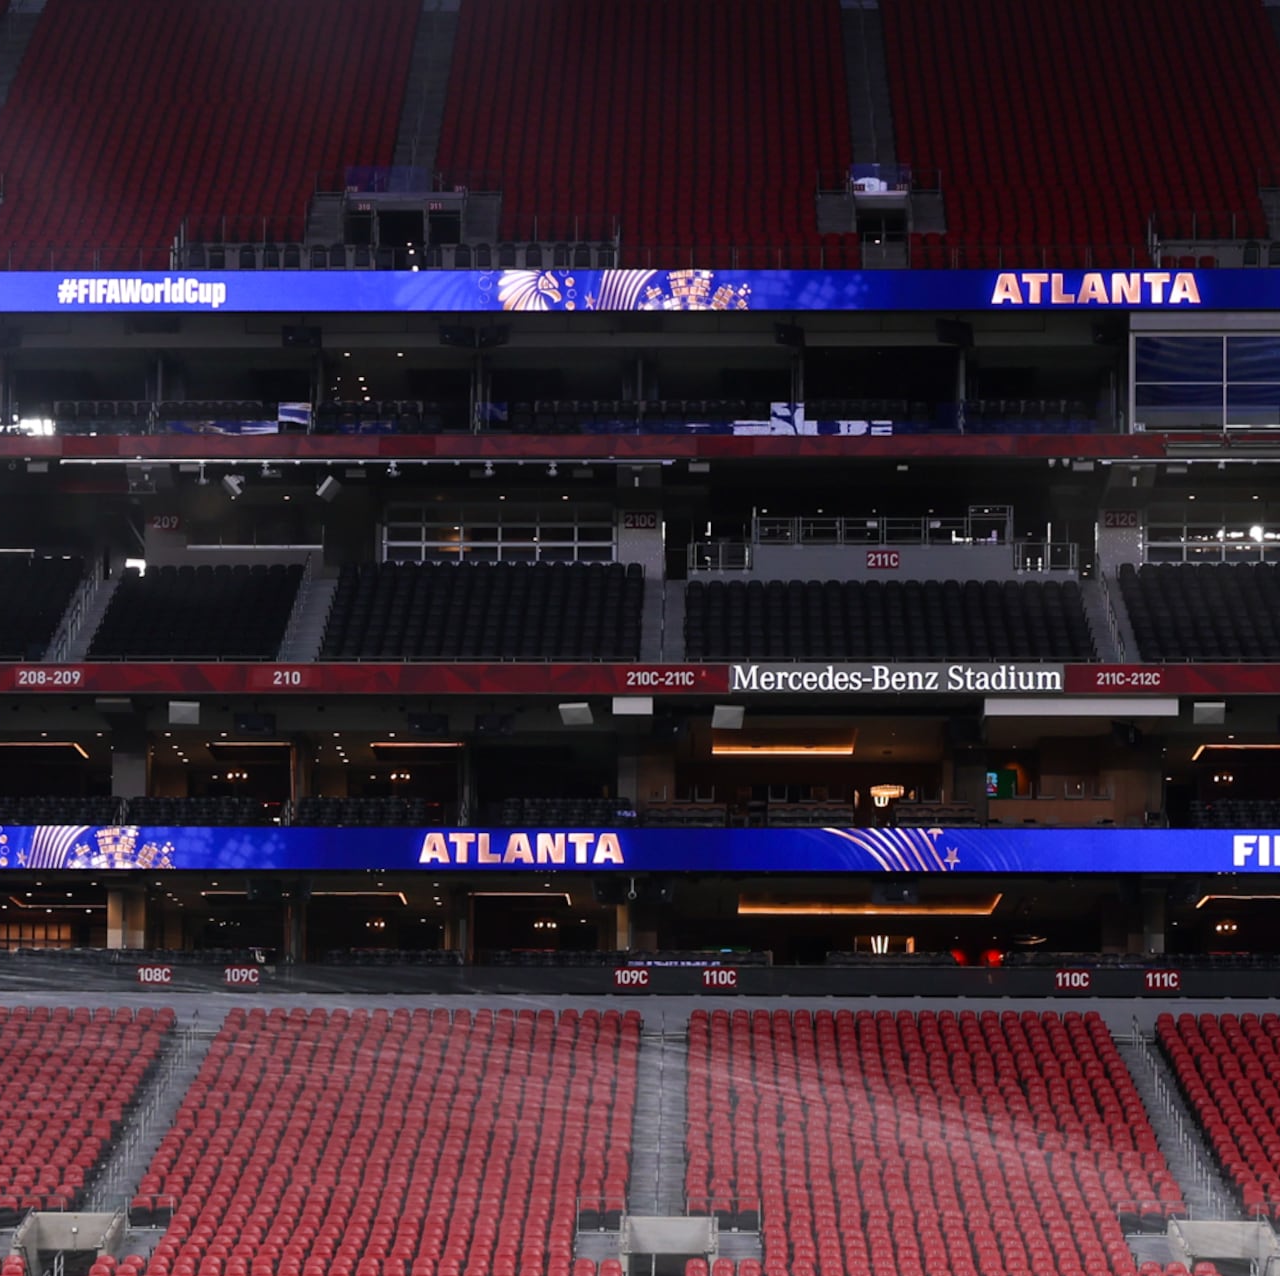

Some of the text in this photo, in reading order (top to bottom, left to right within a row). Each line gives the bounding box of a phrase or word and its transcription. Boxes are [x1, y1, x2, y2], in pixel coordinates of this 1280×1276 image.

[57, 277, 227, 308] #FIFAWorldCup
[991, 272, 1201, 305] ATLANTA
[152, 514, 180, 529] 209
[625, 513, 656, 528] 210C
[1105, 512, 1137, 527] 212C
[866, 552, 899, 567] 211C
[18, 670, 81, 686] 208-209
[272, 670, 301, 686] 210
[626, 671, 695, 686] 210C-211C
[733, 664, 1062, 691] Mercedes-Benz Stadium
[1096, 672, 1161, 686] 211C-212C
[419, 832, 624, 864] ATLANTA
[137, 967, 172, 983] 108C
[223, 968, 259, 983] 109C
[614, 969, 649, 985] 109C
[702, 970, 737, 985] 110C
[1055, 972, 1090, 987] 110C
[1145, 972, 1179, 988] 111C
